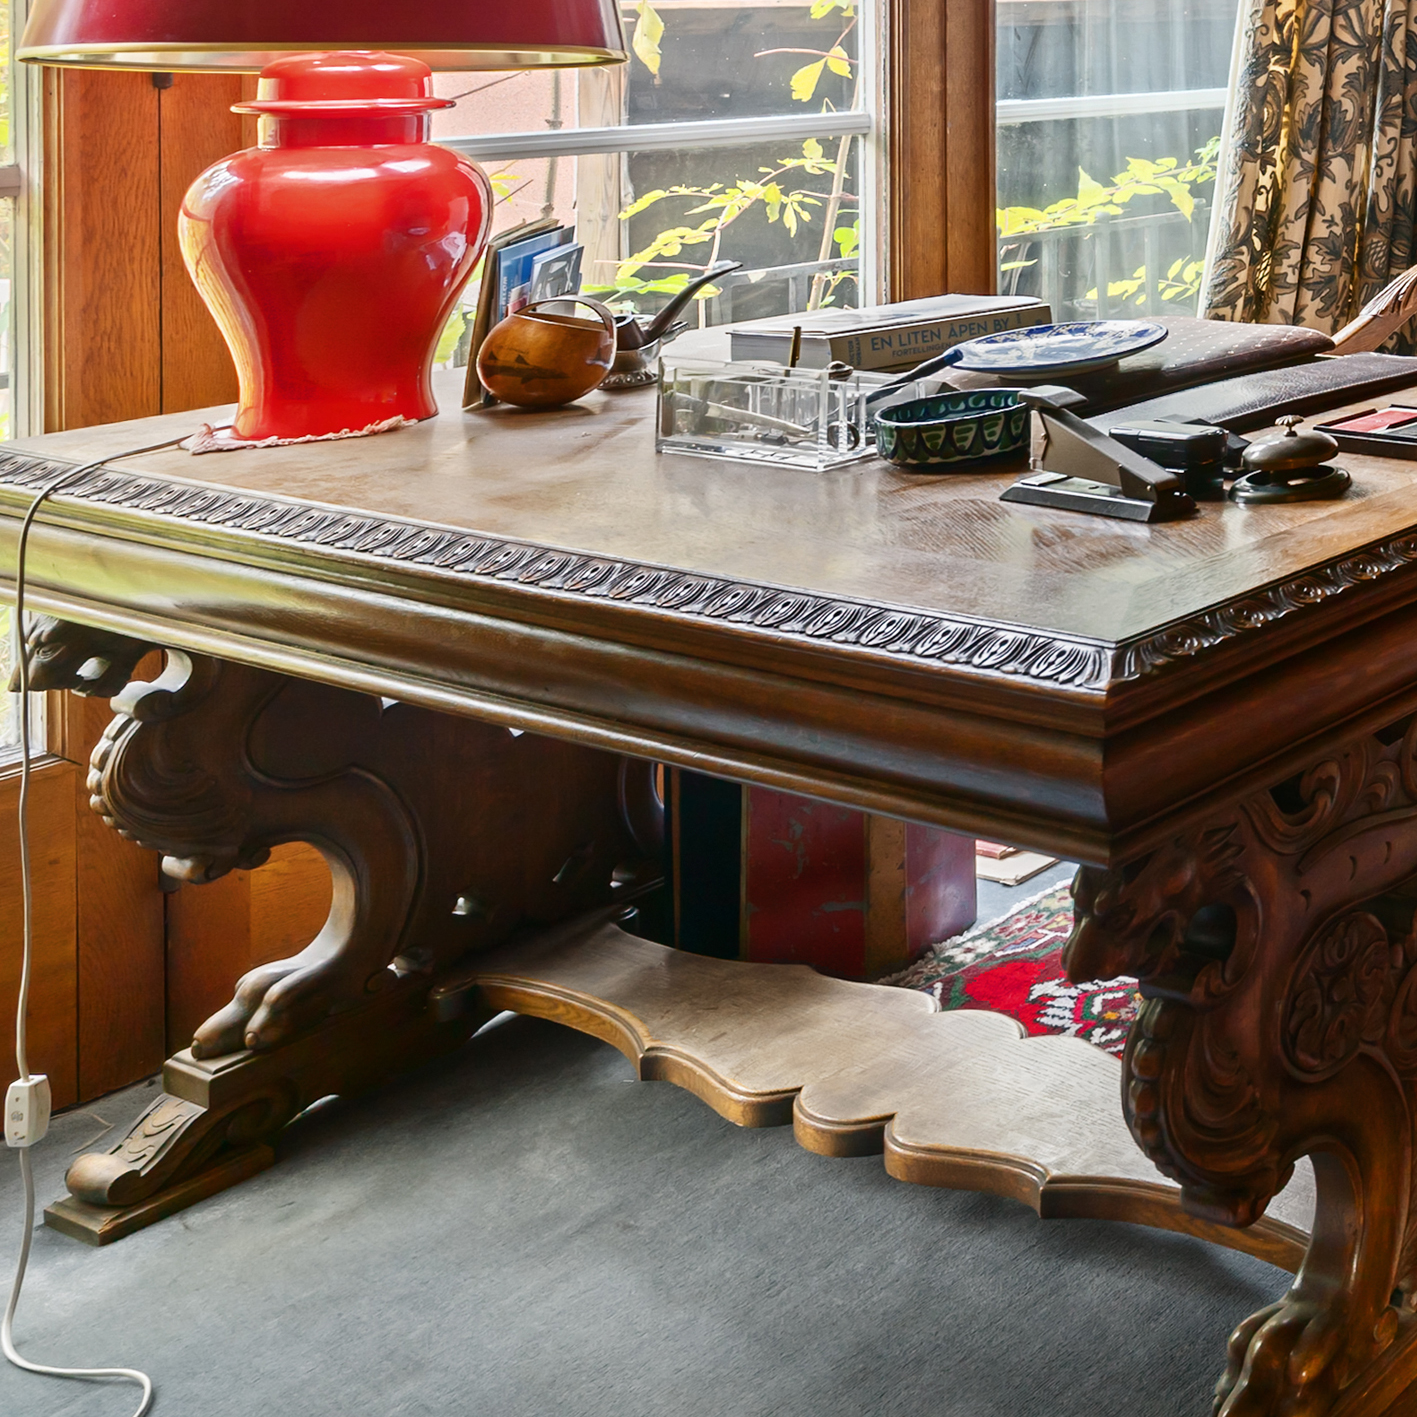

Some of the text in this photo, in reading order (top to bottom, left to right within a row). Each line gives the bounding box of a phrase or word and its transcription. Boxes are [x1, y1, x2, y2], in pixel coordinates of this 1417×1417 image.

[870, 317, 1010, 351] EN LITEN ÅPEN BY
[892, 342, 951, 358] FORTELLINGEN
